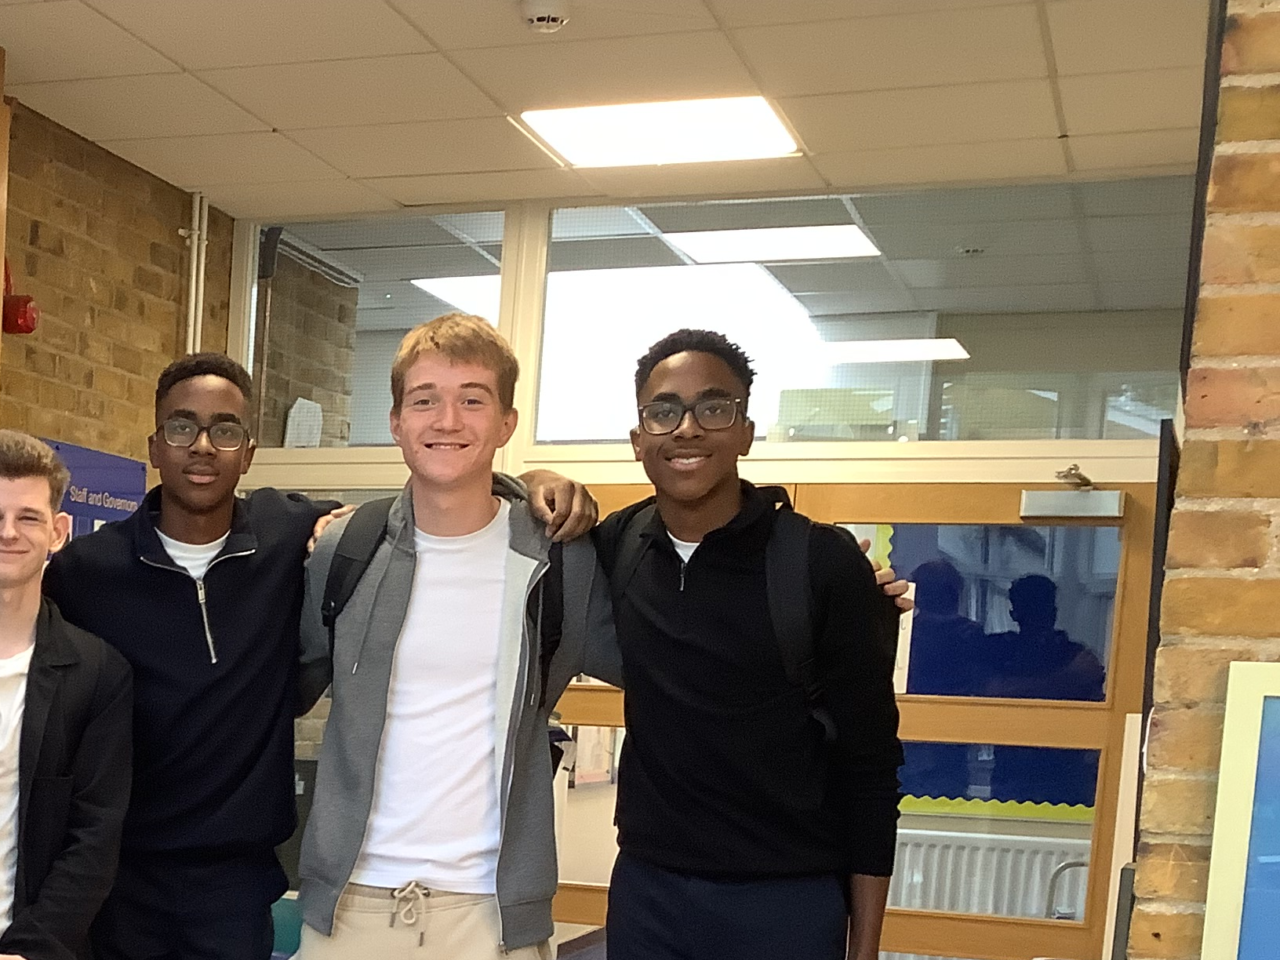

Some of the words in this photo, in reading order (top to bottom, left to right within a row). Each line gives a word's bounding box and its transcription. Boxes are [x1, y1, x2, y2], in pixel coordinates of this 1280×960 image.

[69, 485, 88, 503] Staff
[88, 492, 102, 507] and
[102, 492, 138, 513] Governors
